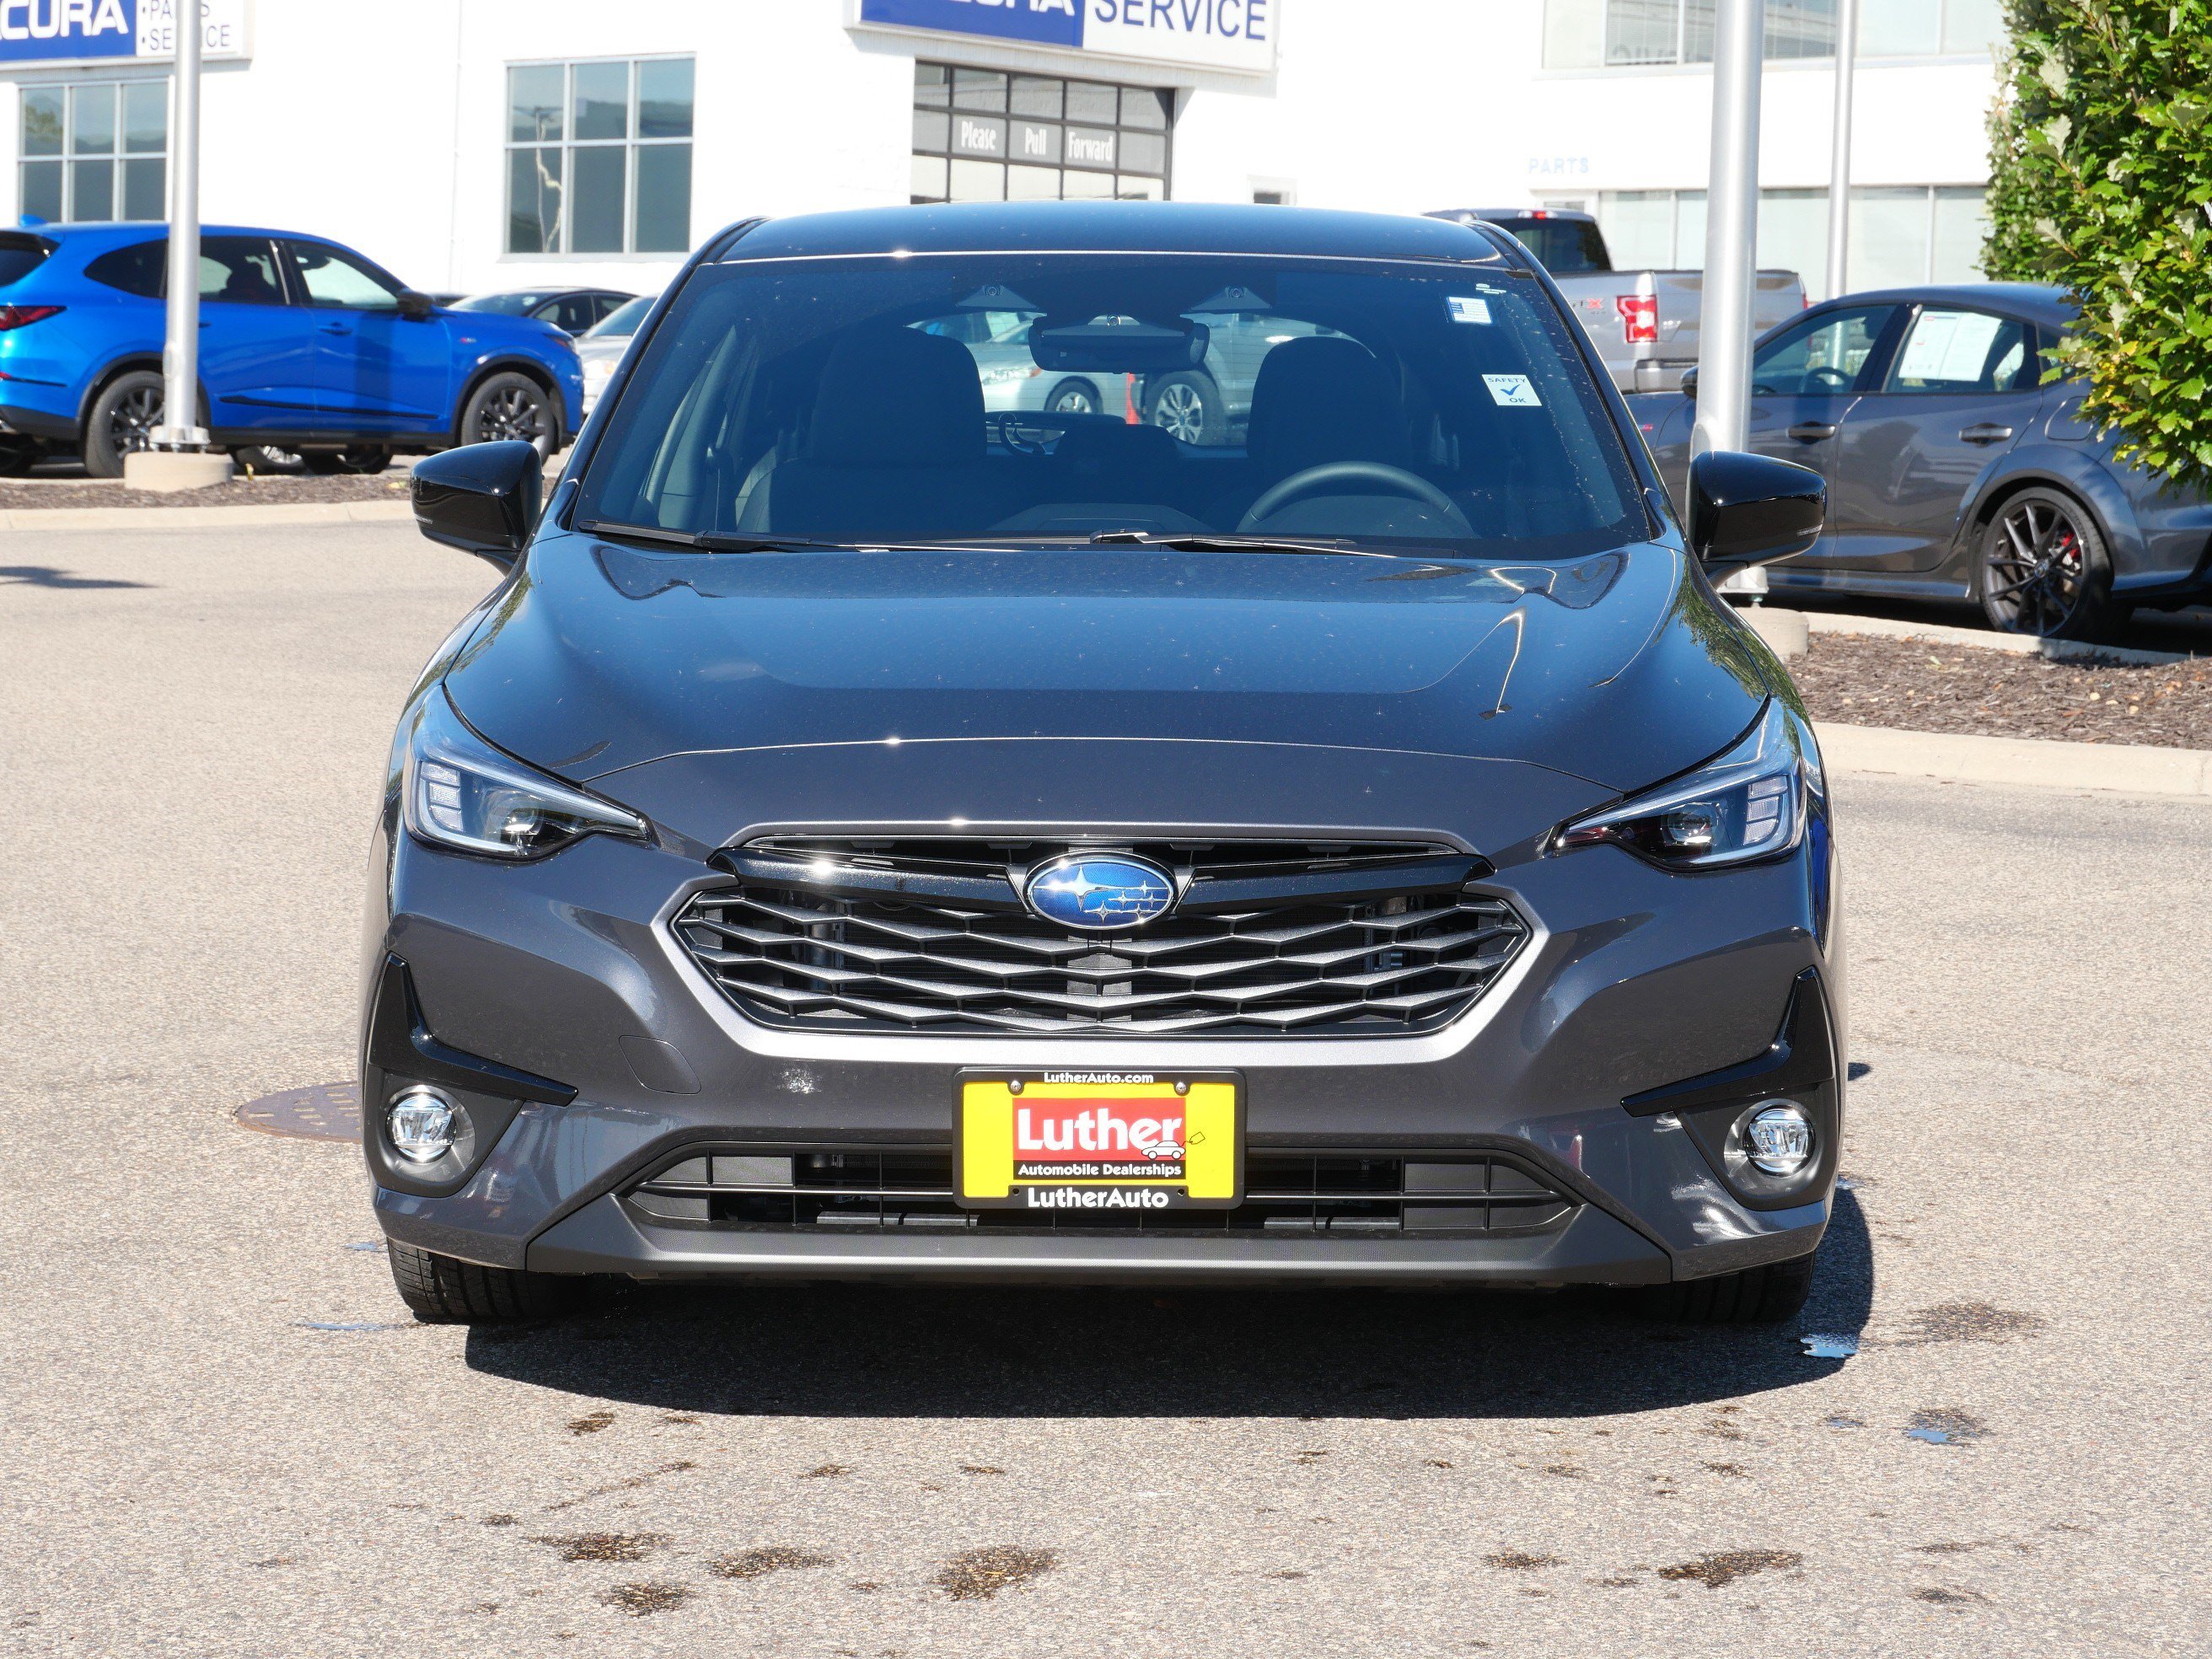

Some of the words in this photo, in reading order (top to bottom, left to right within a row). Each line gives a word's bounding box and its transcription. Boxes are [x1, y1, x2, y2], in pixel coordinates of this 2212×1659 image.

[0, 0, 129, 40] CURA
[149, 0, 210, 20] PAS
[150, 24, 230, 51] SECE
[961, 121, 996, 151] Please
[1025, 127, 1047, 155] Pull
[1068, 132, 1114, 162] Forward
[1527, 157, 1590, 174] PARTS
[1044, 1072, 1154, 1084] LutherAuto.com
[1017, 1108, 1182, 1152] Luther
[1017, 1164, 1099, 1176] Automobile
[1103, 1164, 1182, 1177] Dealerships
[1028, 1187, 1169, 1208] LutherAuto
